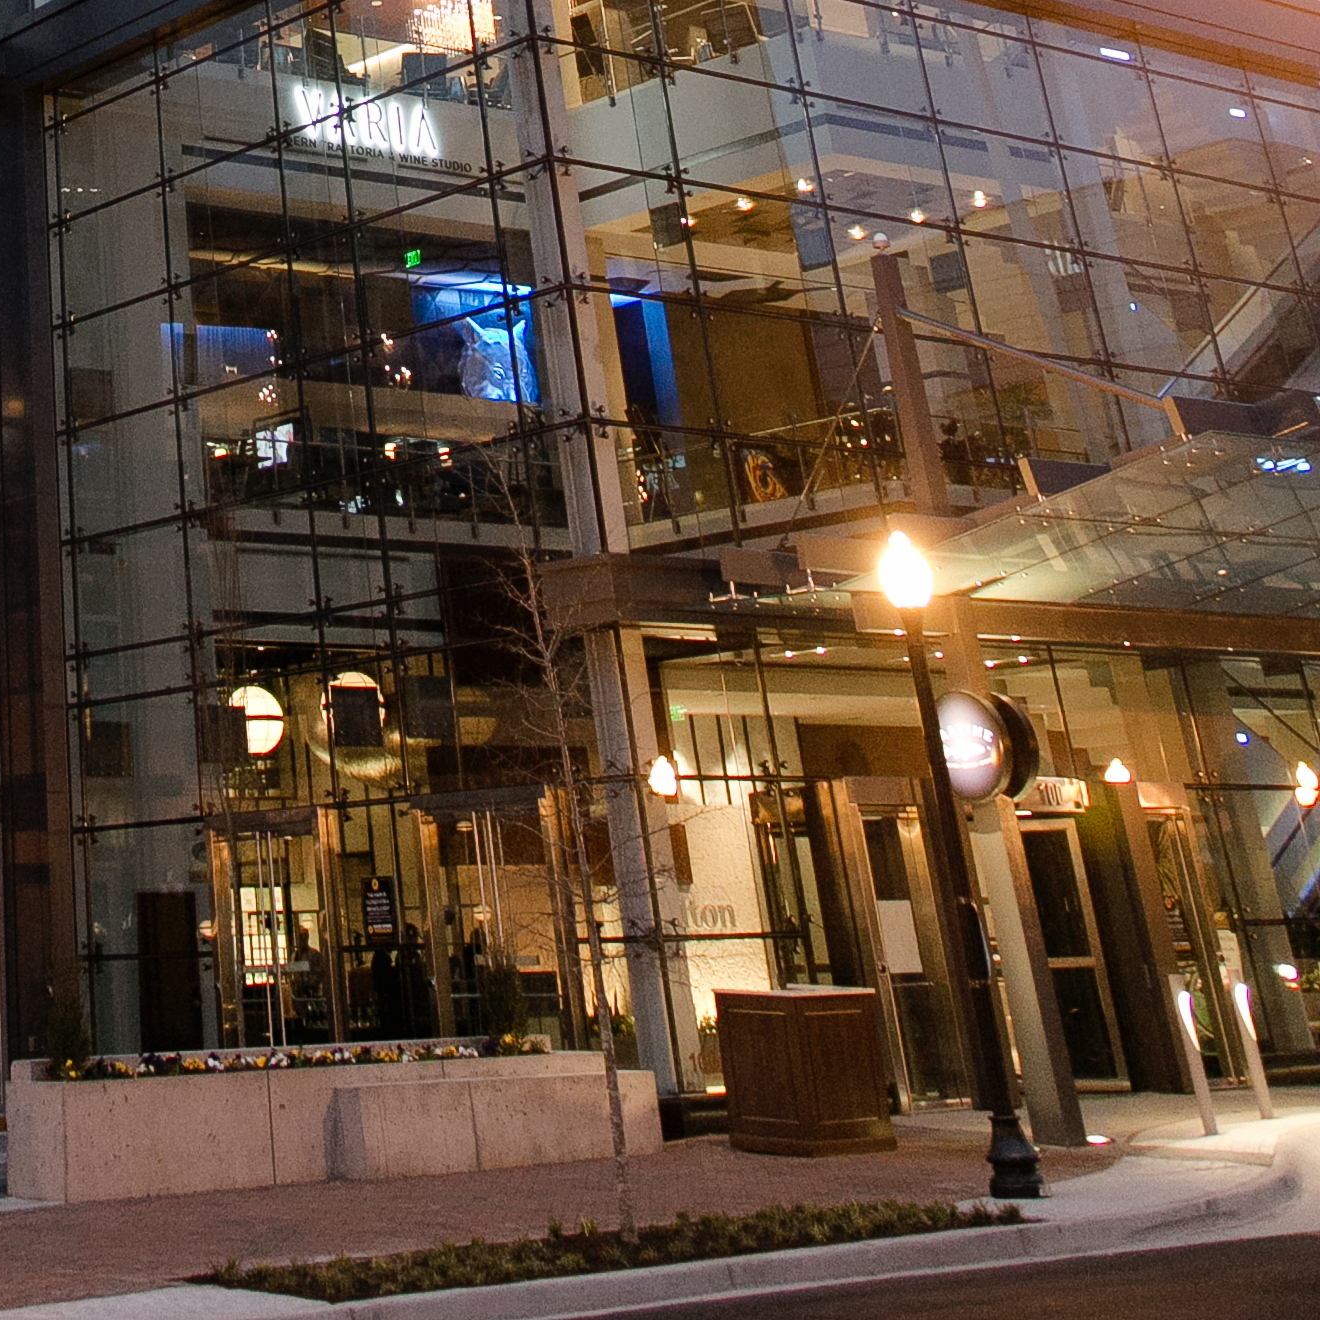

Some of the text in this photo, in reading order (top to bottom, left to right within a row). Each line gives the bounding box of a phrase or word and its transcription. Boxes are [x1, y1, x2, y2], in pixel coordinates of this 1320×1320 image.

[297, 86, 438, 152] VARIA
[398, 152, 428, 167] WINE
[431, 158, 473, 174] STUDIO
